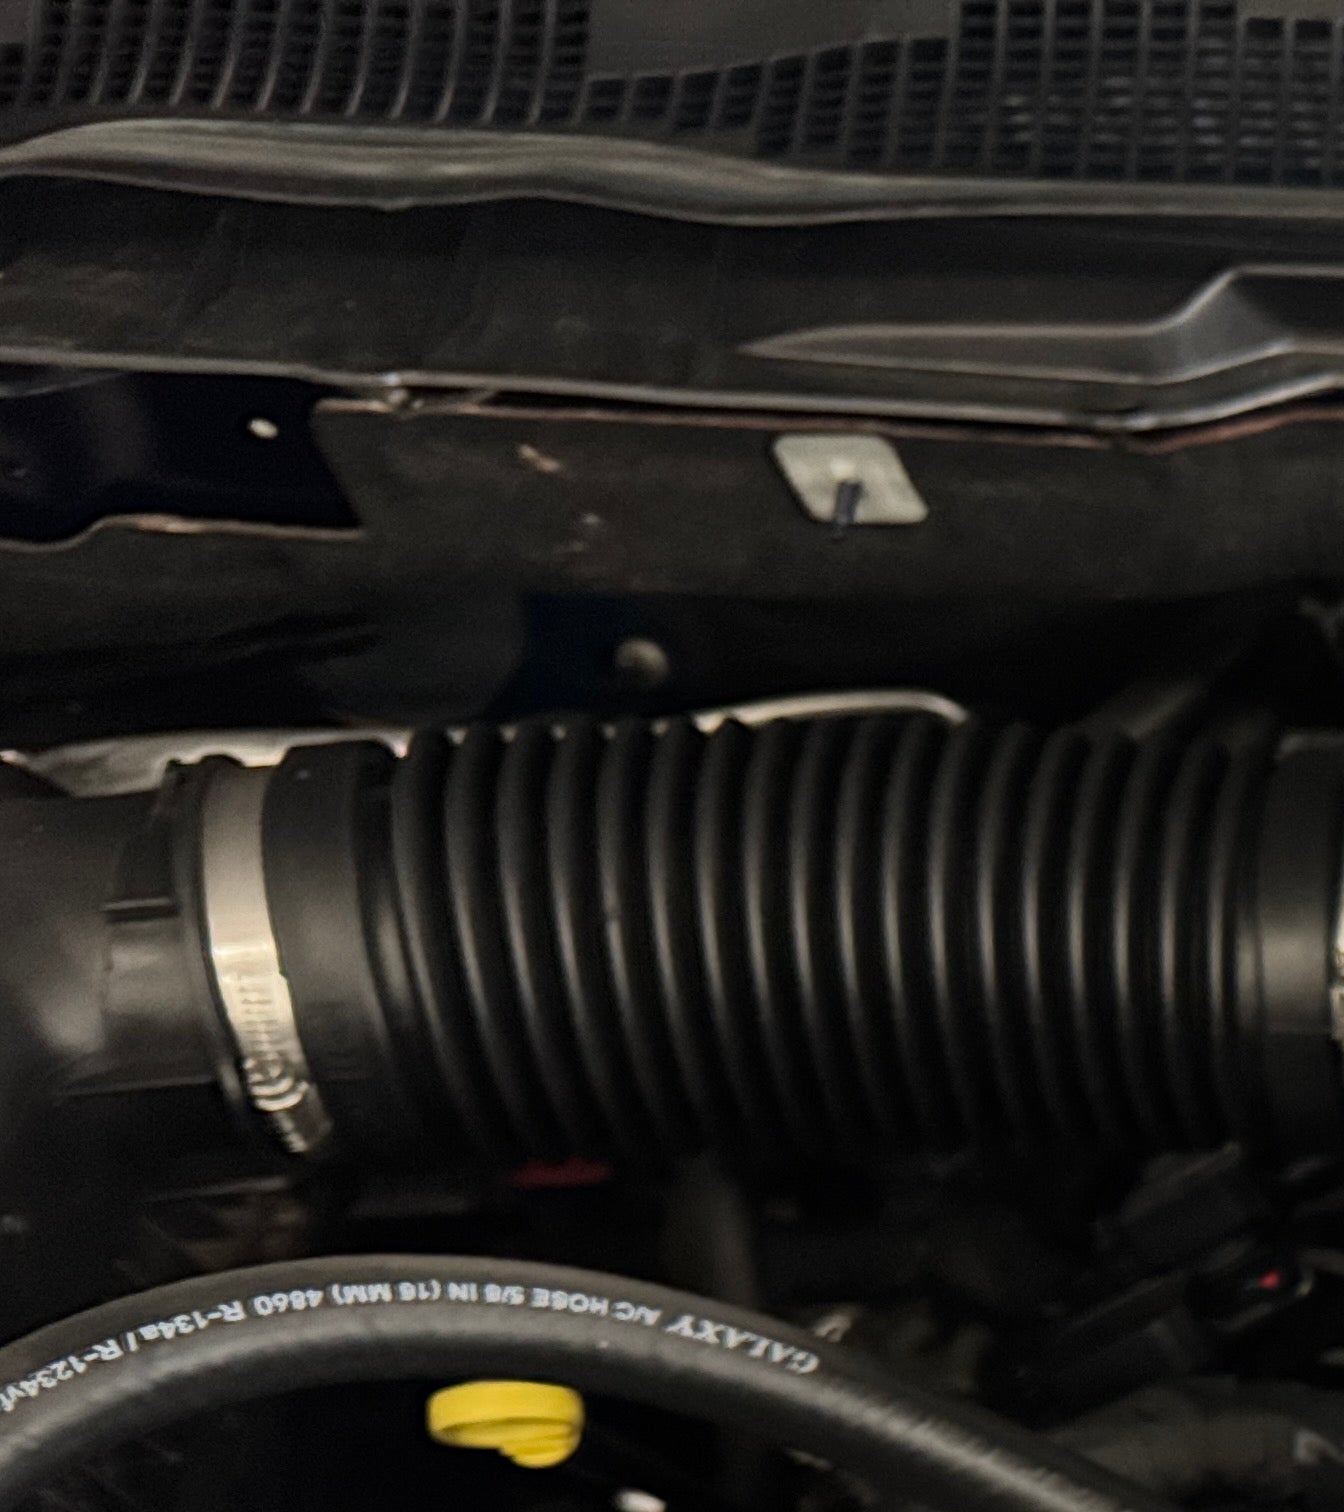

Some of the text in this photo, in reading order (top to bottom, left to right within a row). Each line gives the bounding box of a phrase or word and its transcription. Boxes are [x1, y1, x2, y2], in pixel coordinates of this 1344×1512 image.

[252, 1289, 323, 1316] 4860
[447, 1281, 478, 1302] IN
[529, 1286, 609, 1317] HOSE
[138, 1300, 247, 1341] R-134a
[610, 1301, 663, 1326] A/C
[663, 1313, 821, 1375] GALAXY
